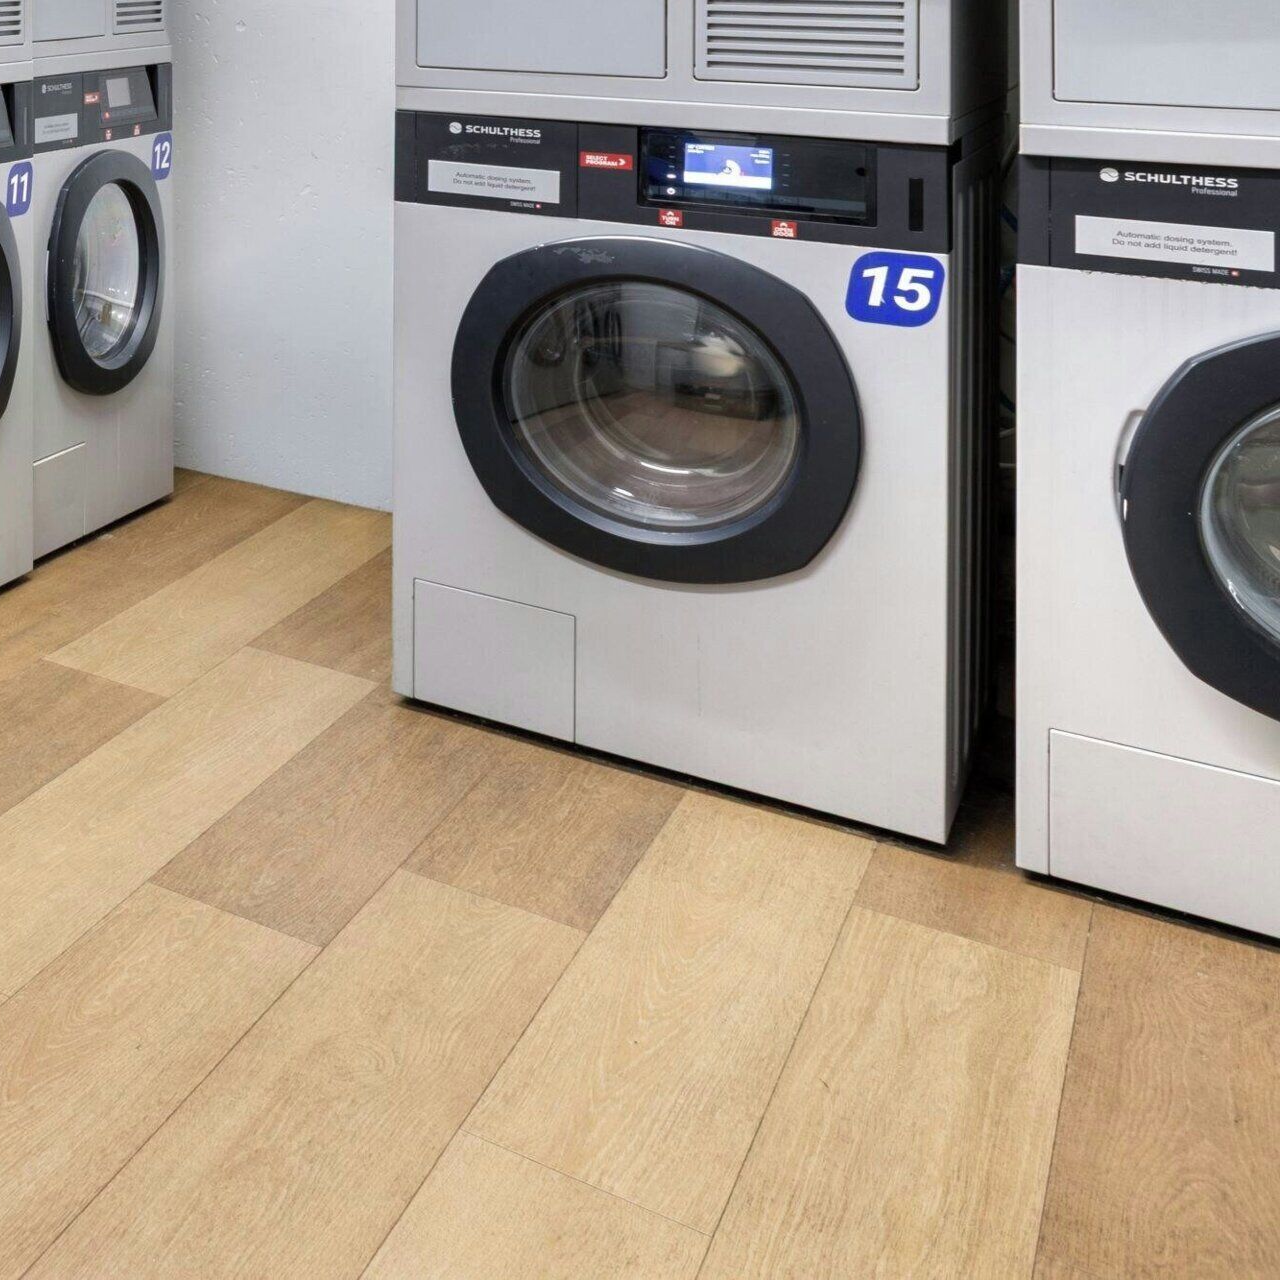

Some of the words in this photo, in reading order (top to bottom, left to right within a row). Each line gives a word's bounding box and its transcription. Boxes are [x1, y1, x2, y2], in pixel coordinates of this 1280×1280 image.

[466, 125, 541, 137] SCHULTHESS
[155, 142, 170, 169] 12
[456, 172, 485, 180] Automatic
[487, 175, 508, 183] dosing
[1124, 172, 1238, 188] SCHULTHESS
[10, 172, 28, 204] 11
[487, 181, 503, 189] liquid
[504, 183, 535, 192] detergent!
[1191, 187, 1237, 196] Professional
[1117, 230, 1161, 240] Automatic
[1164, 235, 1194, 245] dosing
[1197, 239, 1232, 247] system.
[1144, 241, 1161, 249] add
[1164, 243, 1188, 252] liquid
[1191, 246, 1237, 257] detergent!
[1193, 266, 1210, 274] SWISS
[863, 266, 934, 311] 15
